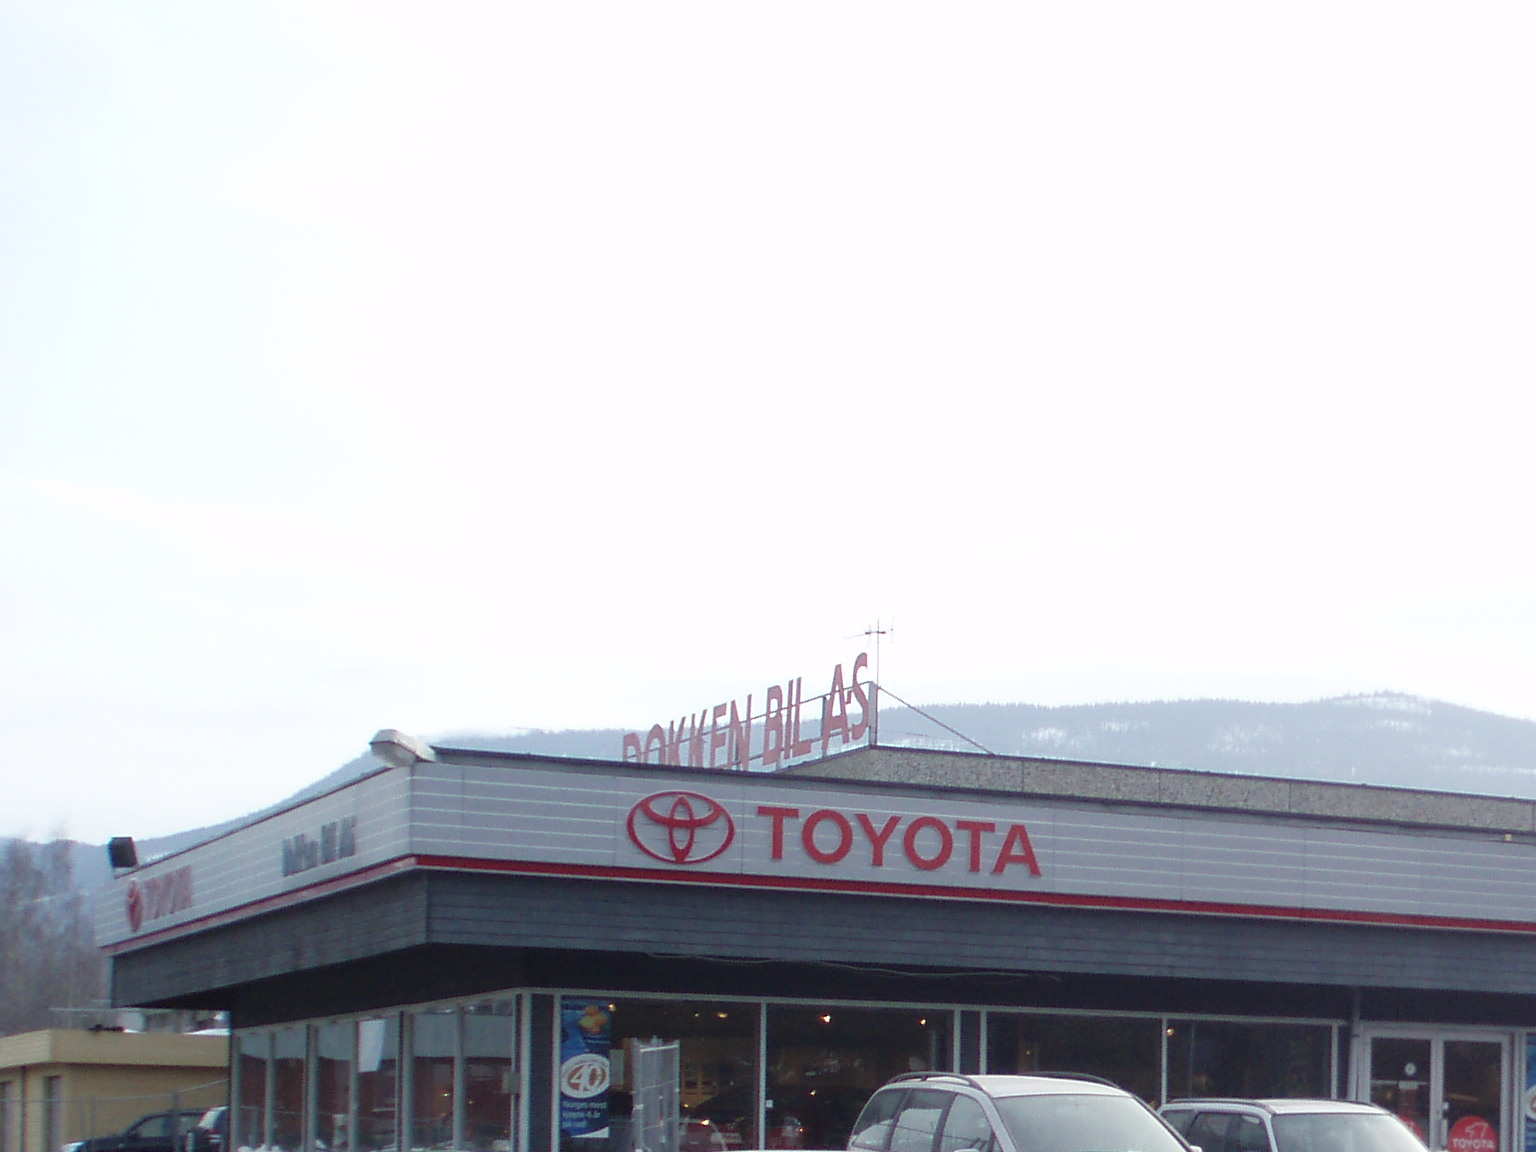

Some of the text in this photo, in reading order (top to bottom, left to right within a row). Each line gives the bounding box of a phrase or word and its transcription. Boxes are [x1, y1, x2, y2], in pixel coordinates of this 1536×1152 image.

[763, 677, 812, 765] BIL
[821, 652, 869, 752] AS
[757, 805, 1041, 878] TOYOTA
[1451, 1137, 1496, 1150] TOYOTA
